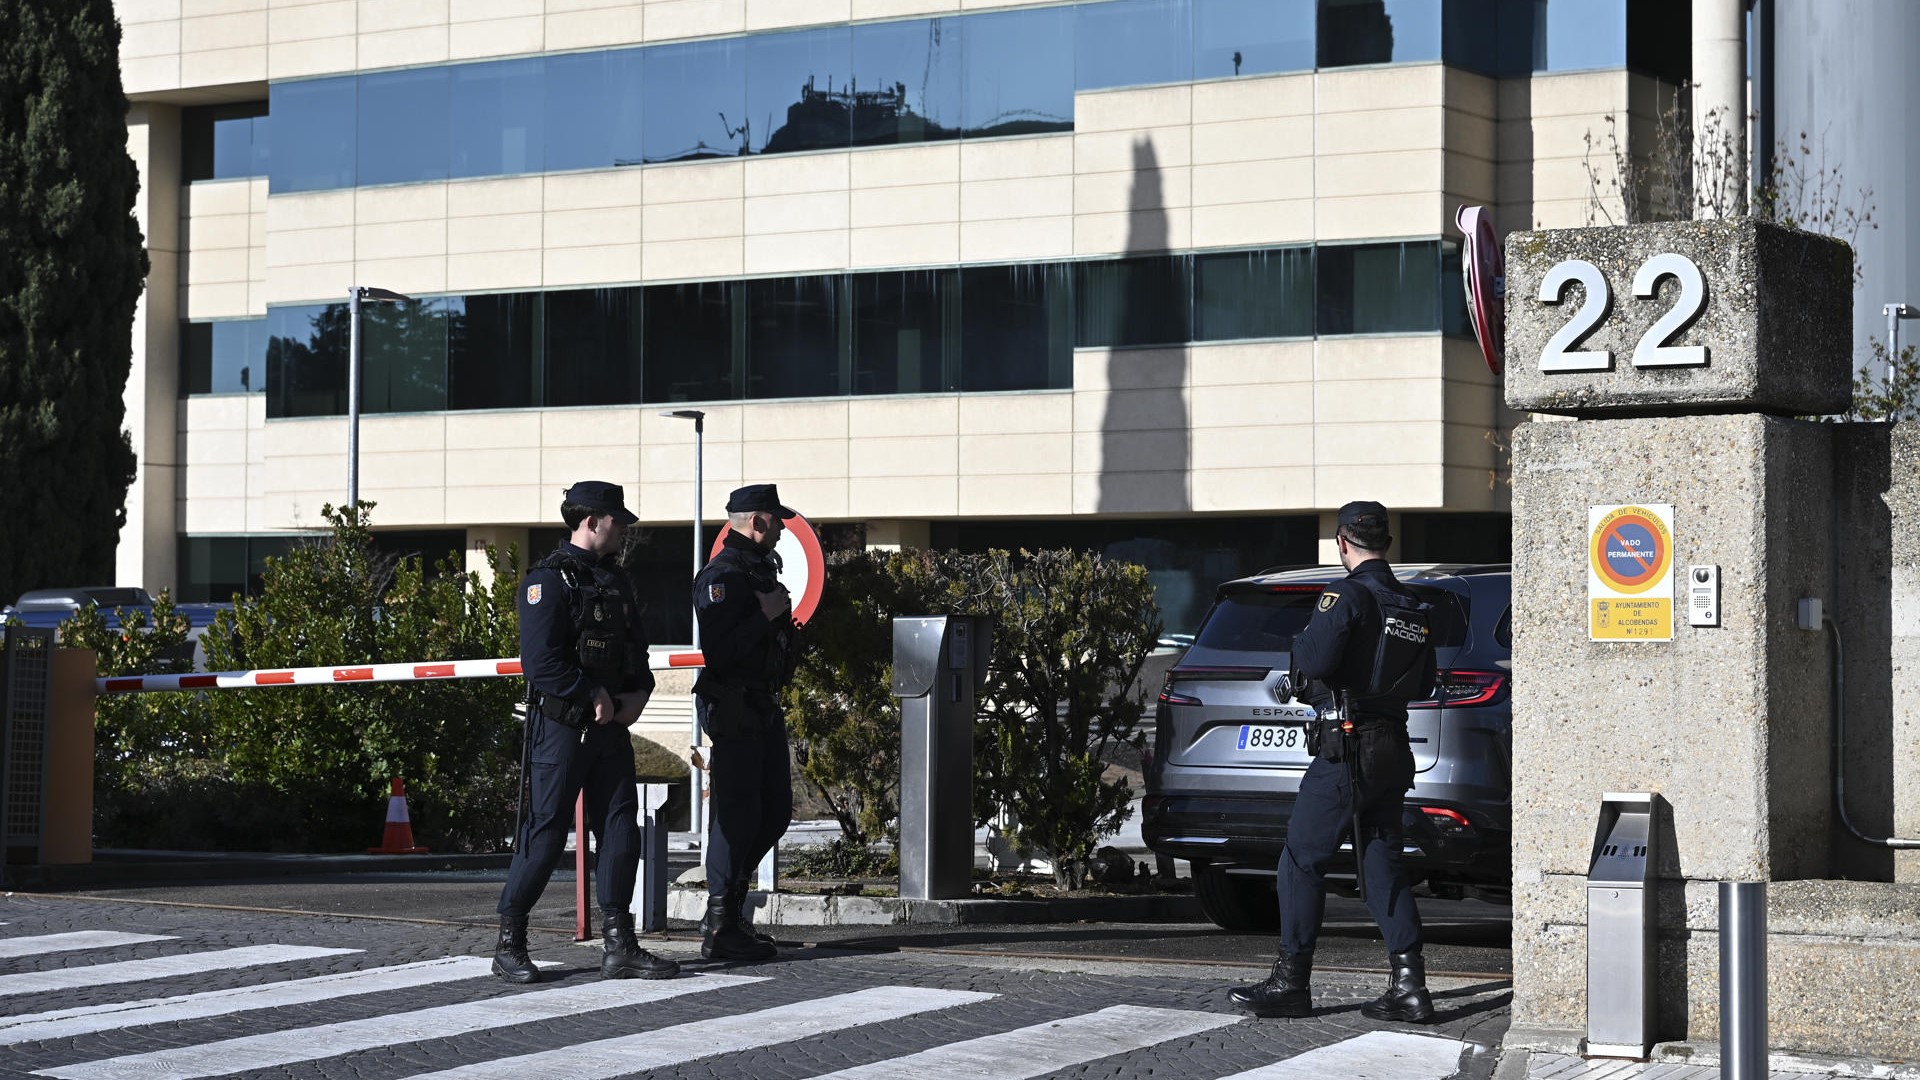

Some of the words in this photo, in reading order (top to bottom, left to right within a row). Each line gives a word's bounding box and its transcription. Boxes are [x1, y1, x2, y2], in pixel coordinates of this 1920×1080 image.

[1538, 253, 1706, 372] 22
[1595, 513, 1615, 535] SALIDA
[1620, 539, 1641, 547] VADO
[1384, 625, 1426, 643] NACIONA
[1385, 617, 1425, 635] POLICIA
[1250, 728, 1298, 748] 8938
